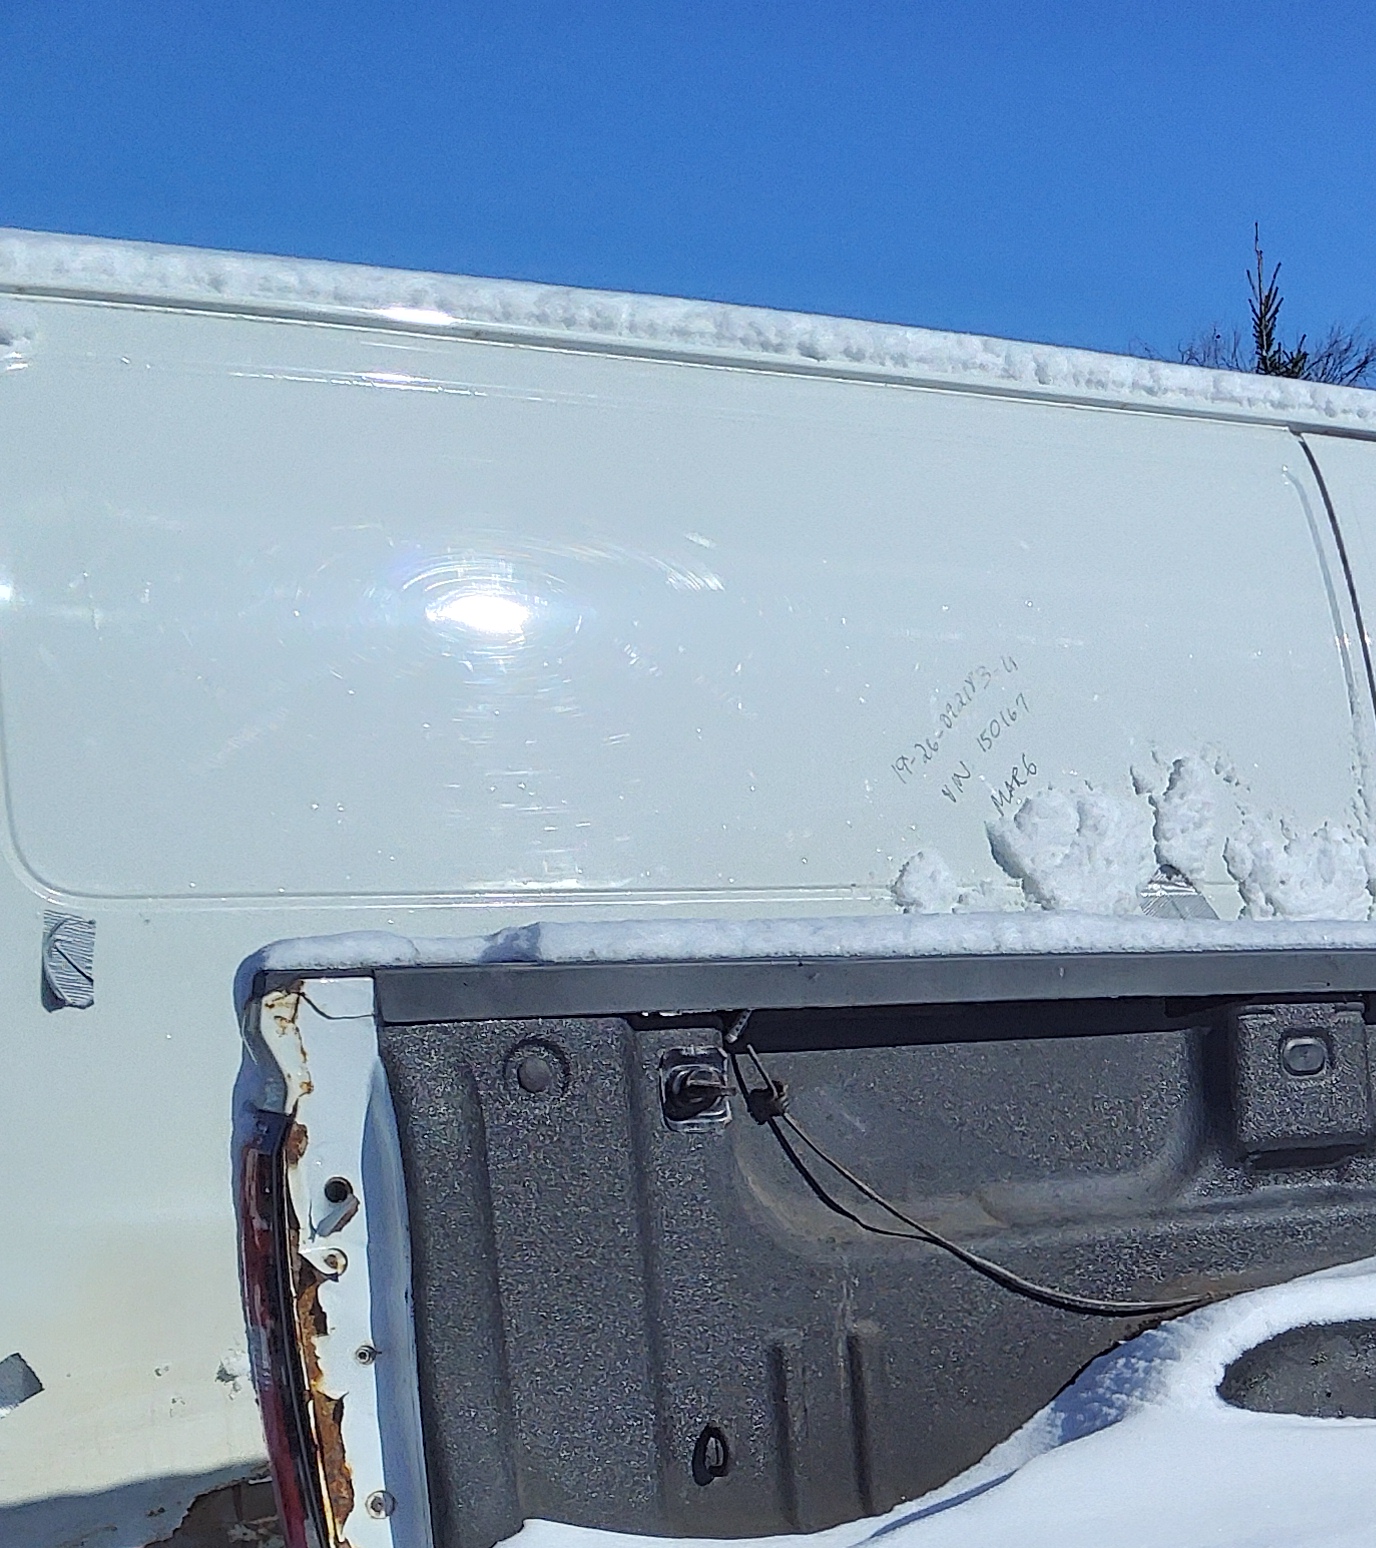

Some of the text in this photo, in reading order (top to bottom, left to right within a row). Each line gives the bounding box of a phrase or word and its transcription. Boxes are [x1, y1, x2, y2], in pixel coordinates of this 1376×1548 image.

[941, 692, 1030, 803] VIN 150167
[990, 752, 1038, 817] MAR 6
